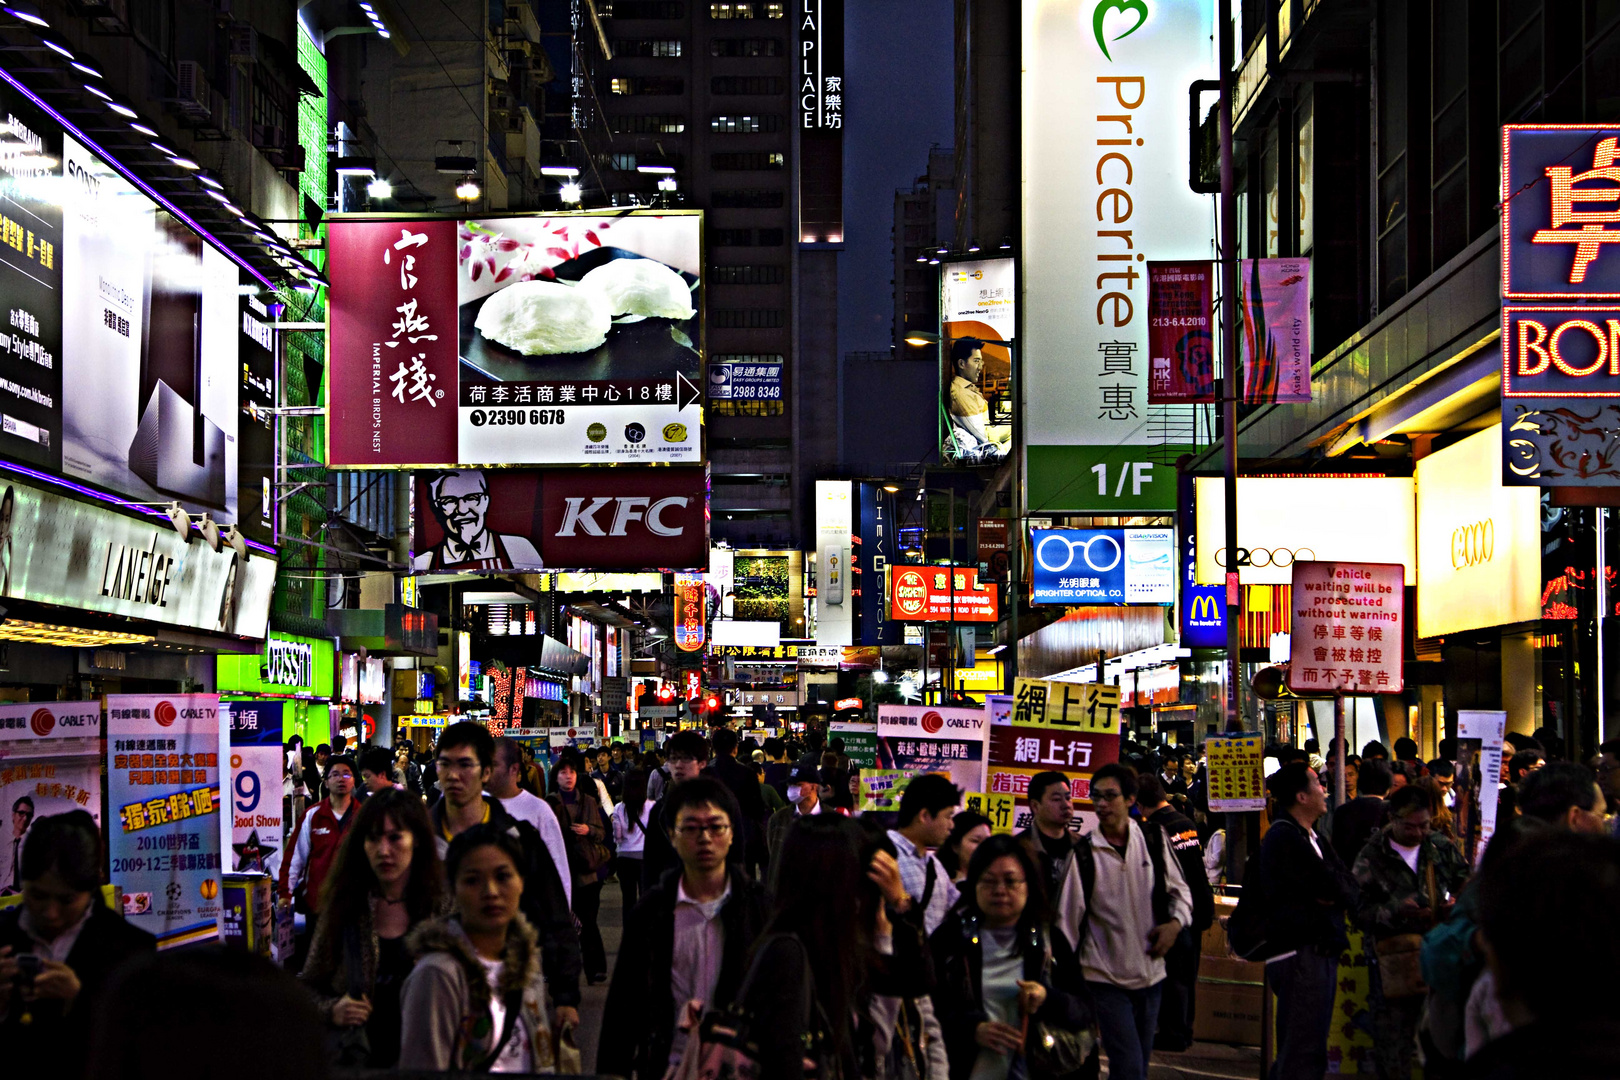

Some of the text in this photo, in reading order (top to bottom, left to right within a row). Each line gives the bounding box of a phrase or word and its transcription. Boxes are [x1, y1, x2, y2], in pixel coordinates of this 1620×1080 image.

[802, 41, 815, 128] PLACE
[825, 76, 841, 129] 家樂坊
[1096, 76, 1145, 327] Pricerite
[1175, 291, 1195, 299] Kong
[383, 229, 439, 408] 官燕棧
[1152, 317, 1206, 327] 21.3-6.4.2010
[1293, 318, 1302, 395] Asia's world city
[1527, 320, 1620, 376] BO
[373, 343, 381, 394] IMPERIAL
[733, 366, 780, 377] 易通集團
[1153, 369, 1170, 380] HK
[1097, 340, 1139, 421] 實惠
[1153, 380, 1170, 391] IFF
[469, 383, 673, 403] 荷李活商業中心18樓
[733, 386, 755, 398] 2988
[757, 386, 780, 398] 8348
[488, 409, 565, 425] 2390 6678
[373, 431, 381, 453] NEST
[1091, 461, 1153, 496] 1/F
[554, 495, 688, 538] KFC
[101, 532, 174, 607] LANEIGE
[1327, 567, 1371, 580] Vehicle
[903, 574, 919, 586] THE
[1059, 577, 1100, 588] 光明眼鏡
[1304, 582, 1392, 594] waiting will be
[1035, 589, 1124, 597] BRIGHTER OPTICAL CO.
[1314, 596, 1383, 607] prosecuted
[903, 600, 921, 612] HOUSE
[1298, 608, 1398, 622] without warning
[1313, 624, 1383, 641] 停車等候
[1312, 646, 1382, 664] 會被檢控
[1302, 667, 1390, 686] 而不予警告
[1014, 683, 1119, 728] 網上行
[59, 715, 84, 727] CABLE
[86, 714, 99, 726] TV
[111, 709, 216, 720] 有線電視 CABLE TV
[880, 716, 984, 729] 有線電視 CABLE TV
[1014, 737, 1093, 767] 網上行
[235, 770, 261, 812] 9
[256, 815, 281, 828] Show
[137, 833, 199, 851] 2010世界盃
